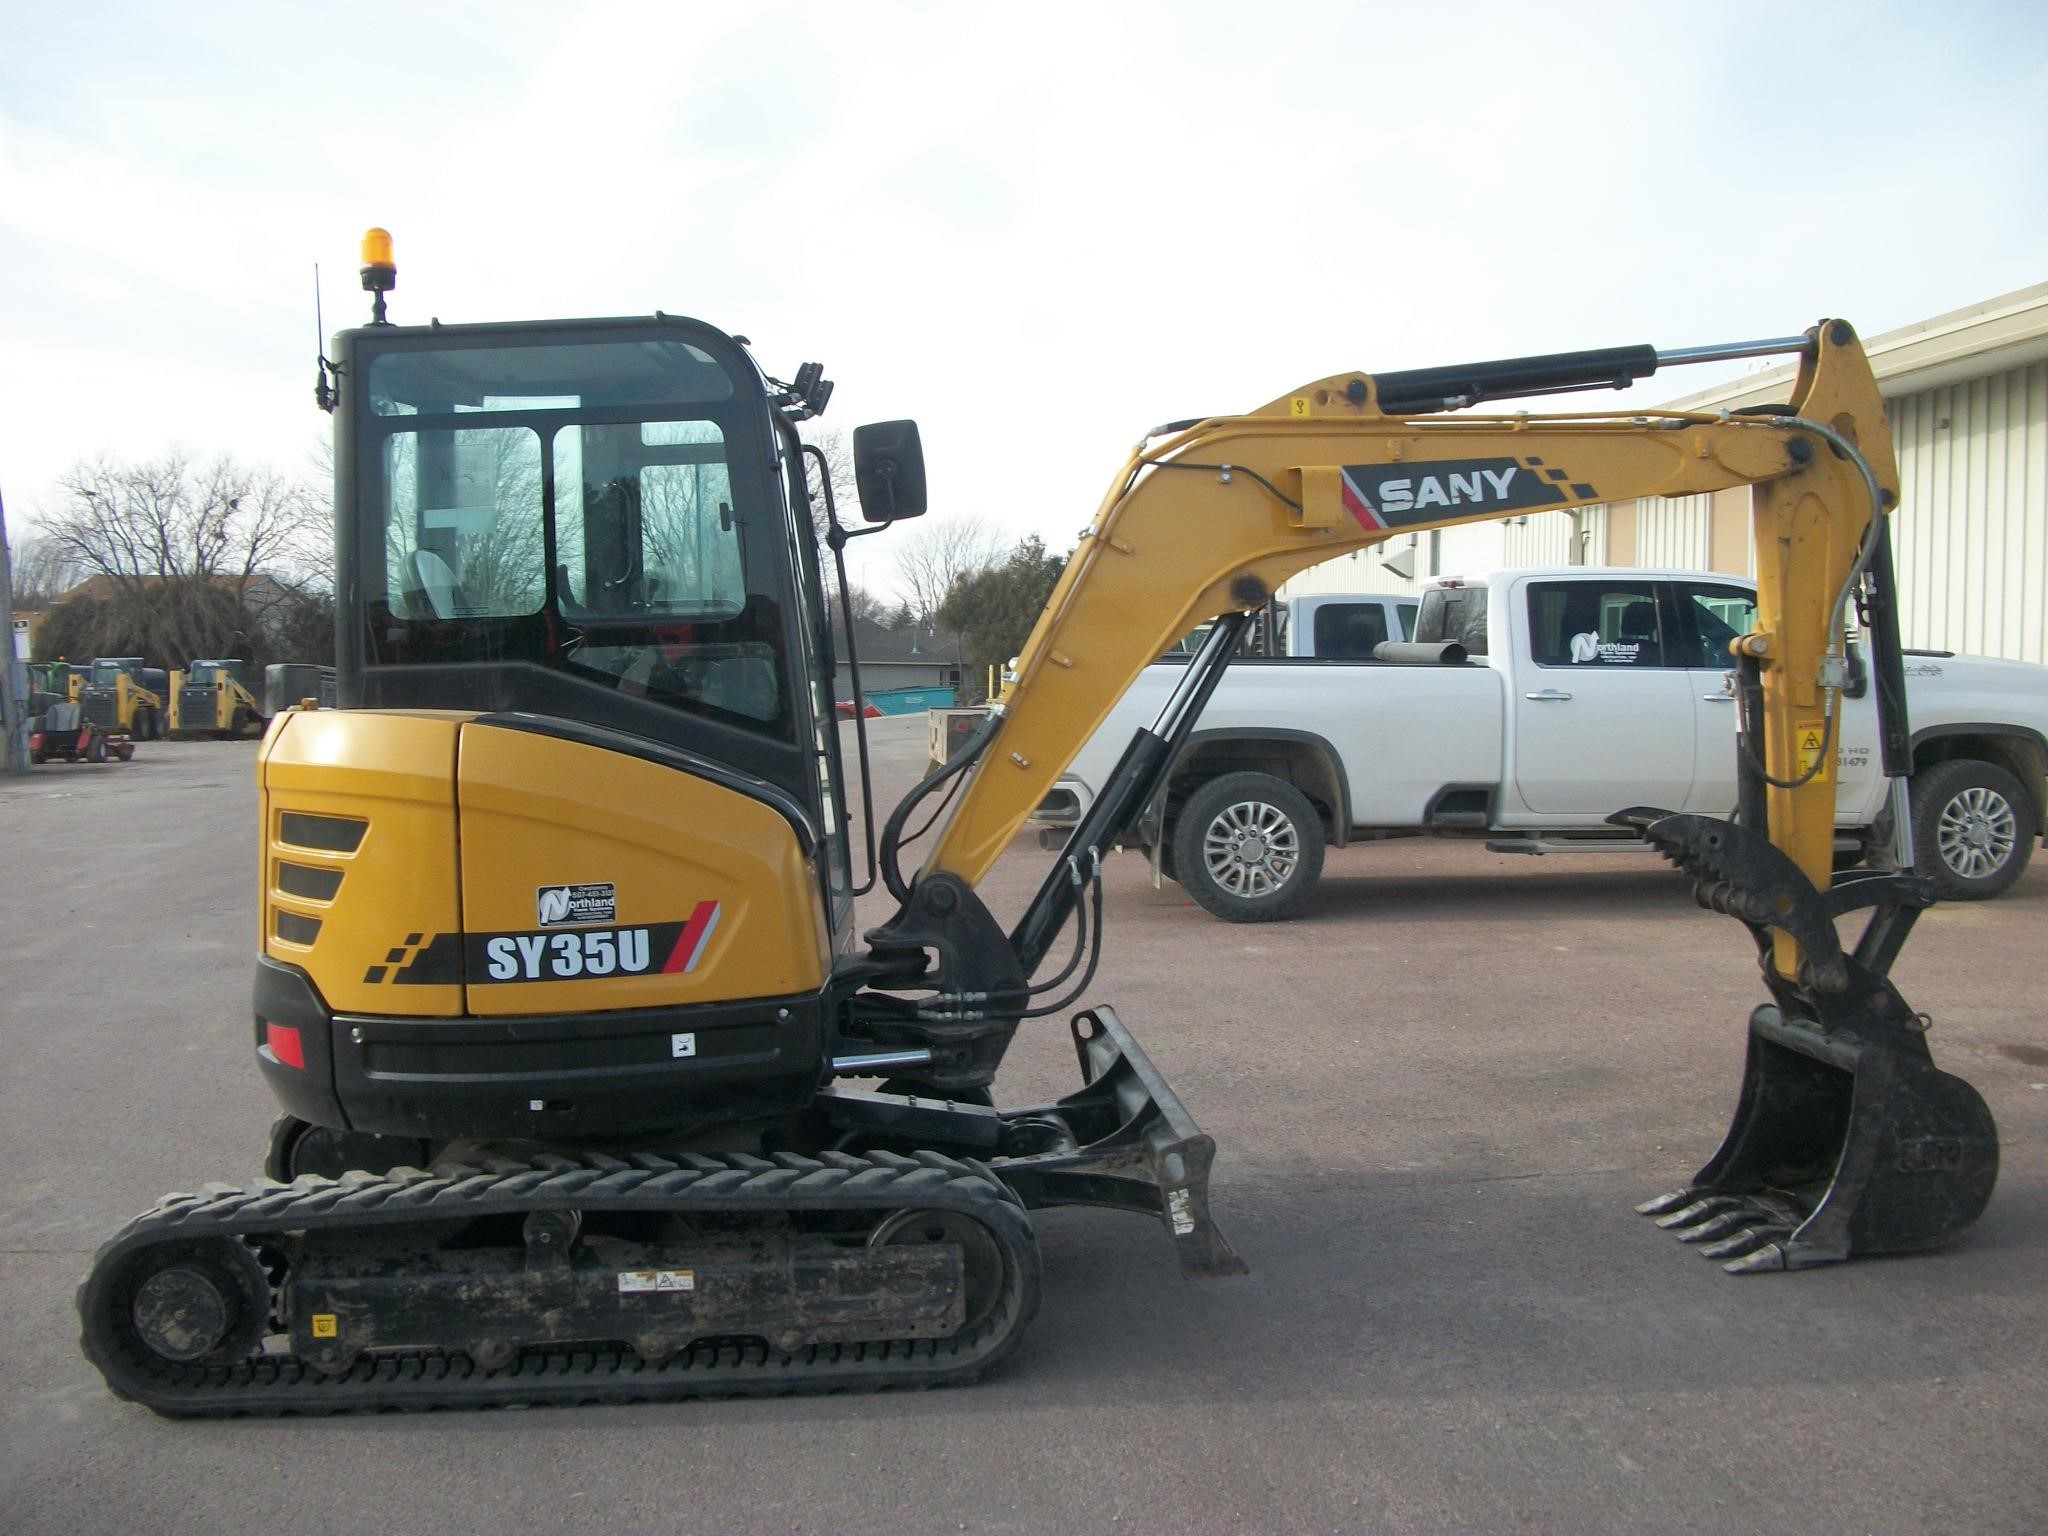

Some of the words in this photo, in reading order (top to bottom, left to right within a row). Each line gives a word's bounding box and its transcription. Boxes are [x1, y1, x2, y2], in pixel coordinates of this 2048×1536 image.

[1378, 467, 1518, 513] SANY
[1570, 630, 1640, 664] Northland
[540, 886, 616, 924] Northland
[486, 929, 651, 980] SY35U
